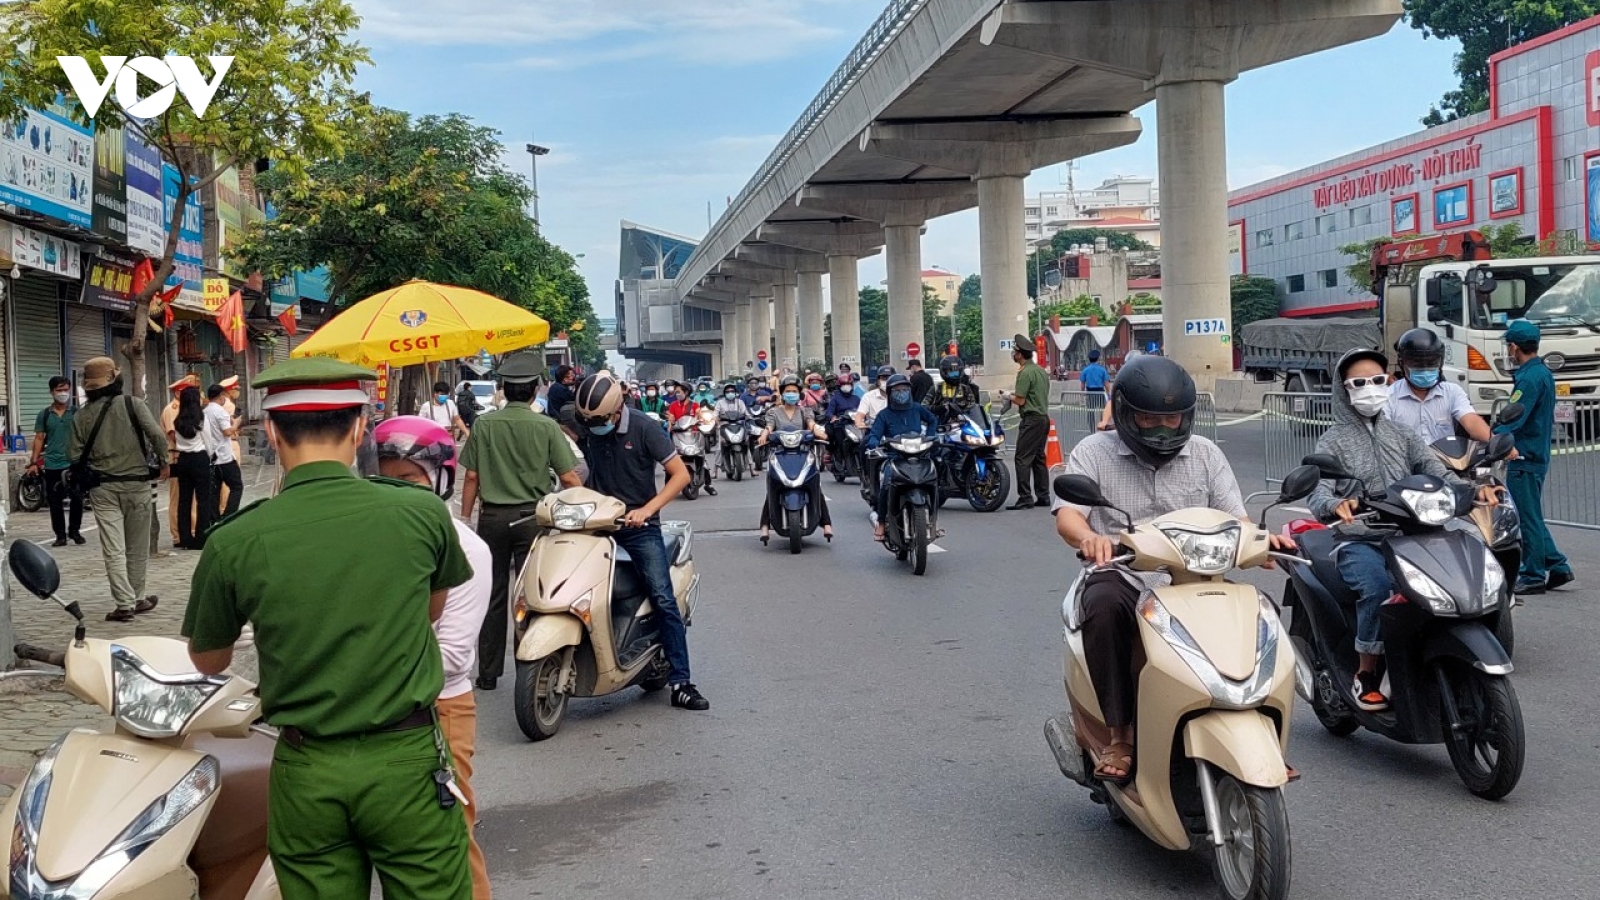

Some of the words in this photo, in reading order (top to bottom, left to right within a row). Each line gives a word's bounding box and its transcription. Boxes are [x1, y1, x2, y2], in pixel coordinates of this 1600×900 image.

[1314, 182, 1331, 213] VẬT
[1334, 176, 1355, 206] LIỆU
[1358, 169, 1377, 198] XÂY
[1379, 163, 1414, 196] DỰNG
[1422, 149, 1445, 185] NỘI
[1447, 136, 1482, 175] THẤT
[1185, 320, 1225, 334] P137A
[389, 334, 441, 353] CSGT
